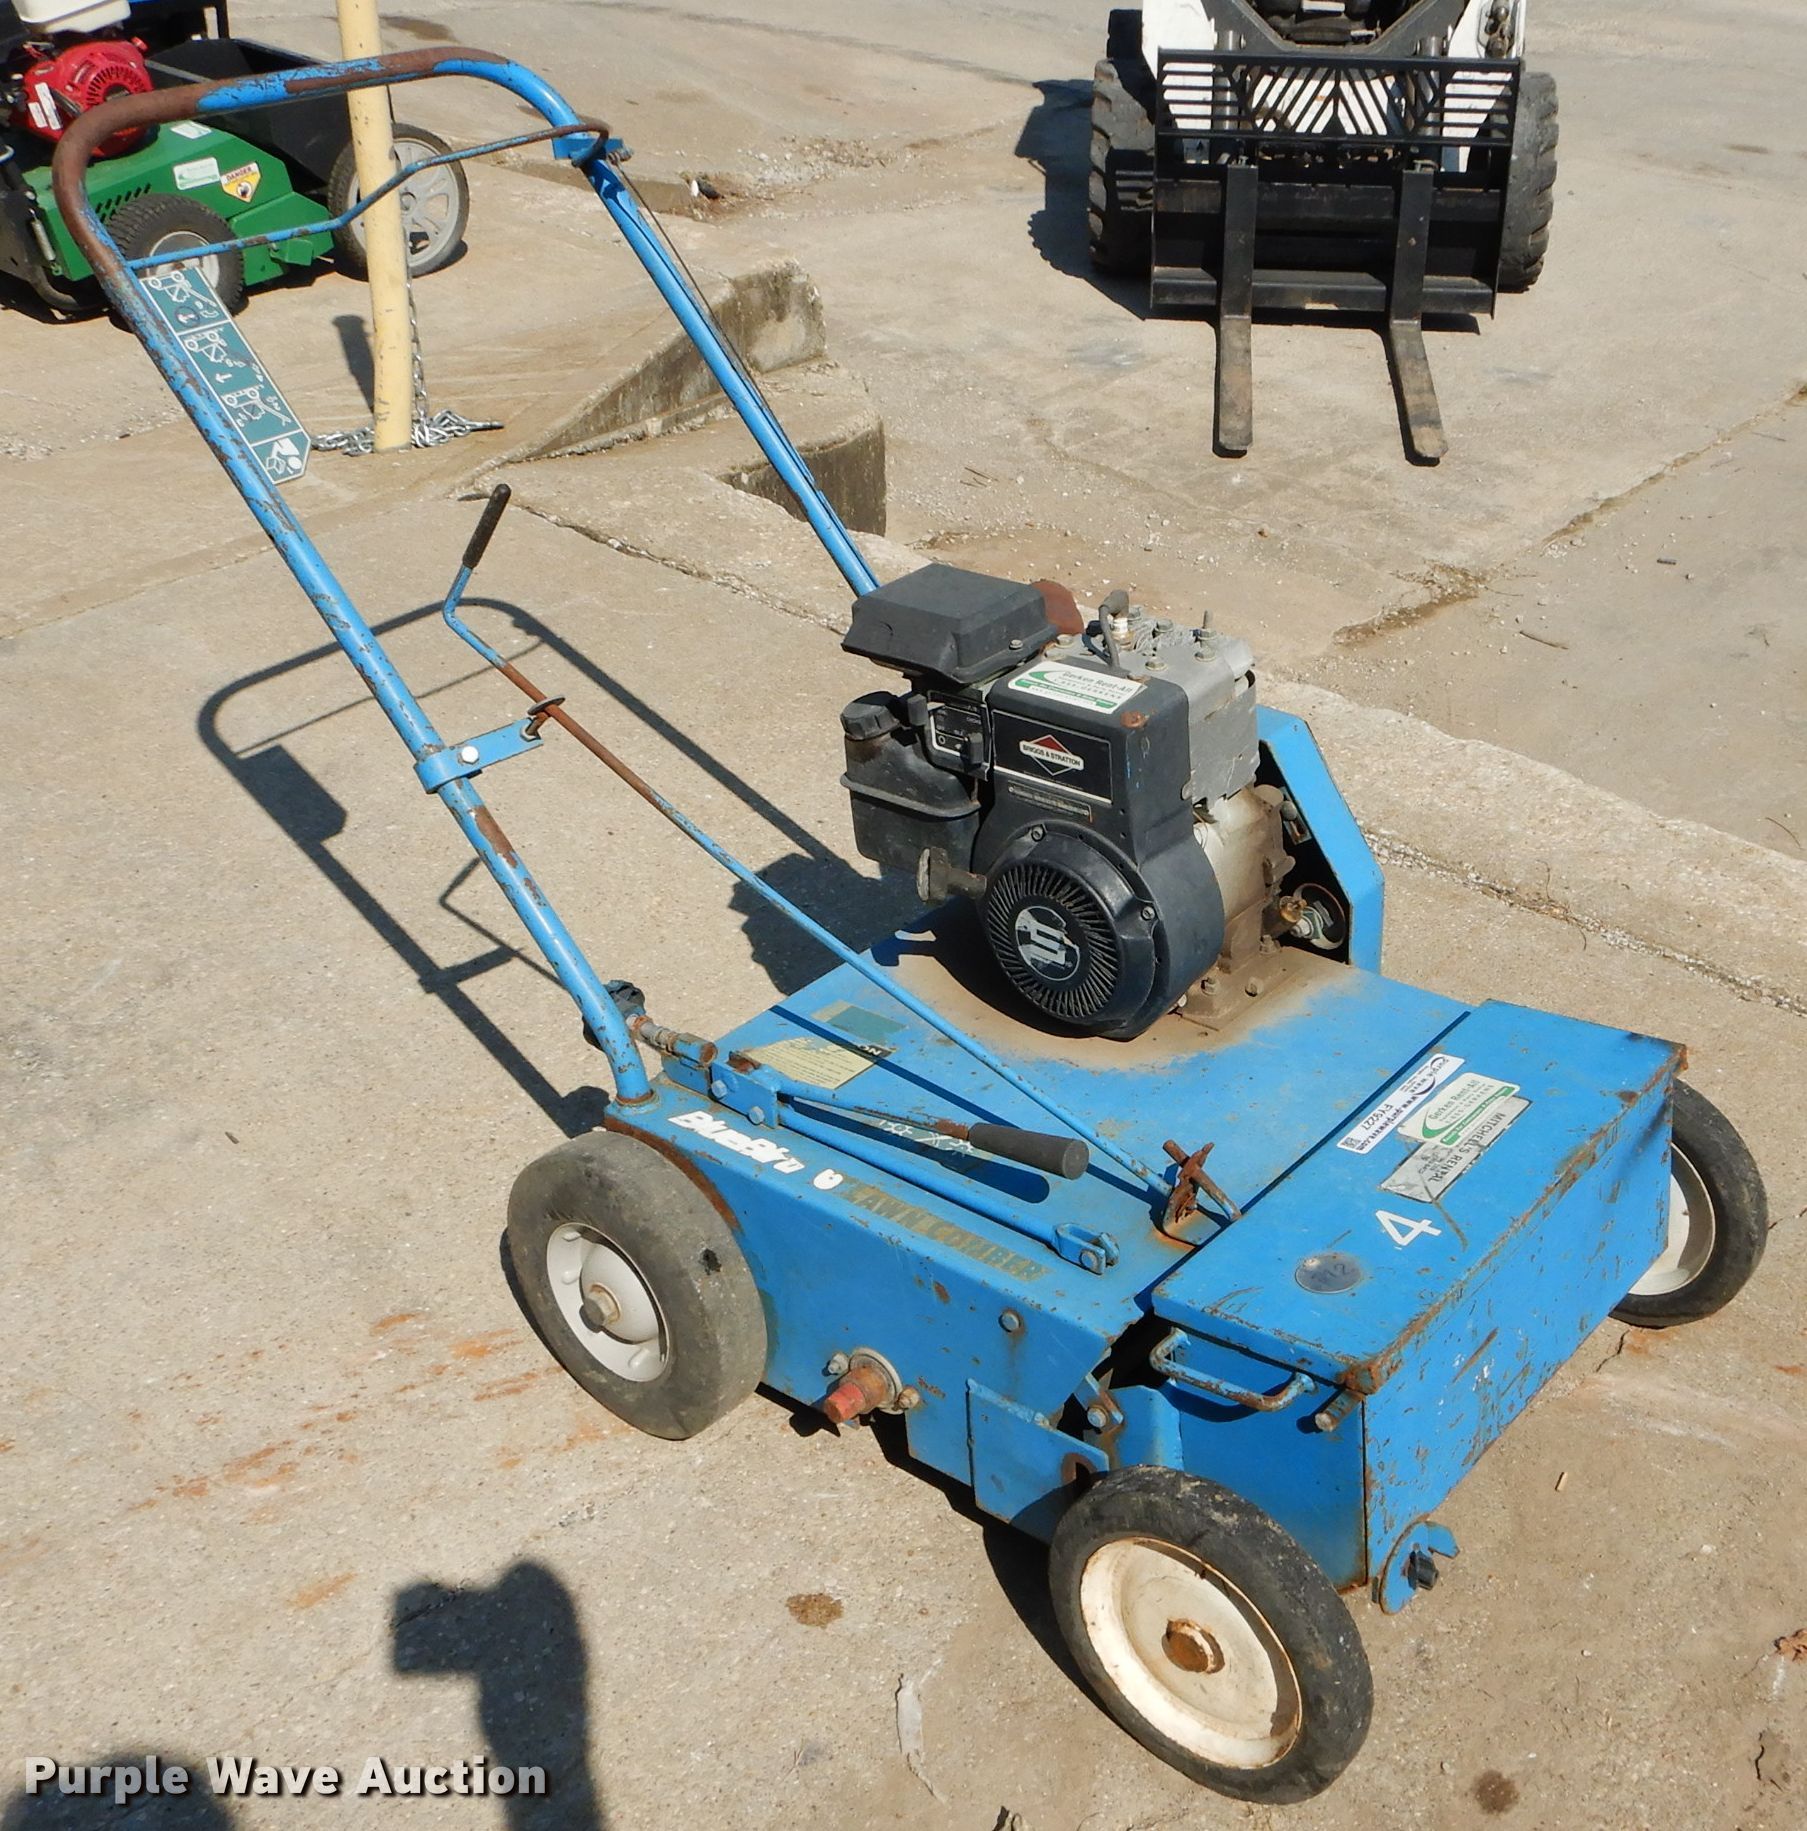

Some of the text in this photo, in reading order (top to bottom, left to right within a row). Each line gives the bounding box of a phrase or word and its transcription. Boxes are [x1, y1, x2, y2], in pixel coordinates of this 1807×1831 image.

[226, 166, 252, 182] DANGER
[1022, 744, 1045, 757] BRIGGS
[1050, 753, 1081, 767] STRATTON
[1428, 1101, 1455, 1120] Gerken
[1451, 1079, 1481, 1101] Rent-All
[1428, 1155, 1463, 1183] RENTAL
[1375, 1209, 1442, 1247] 4
